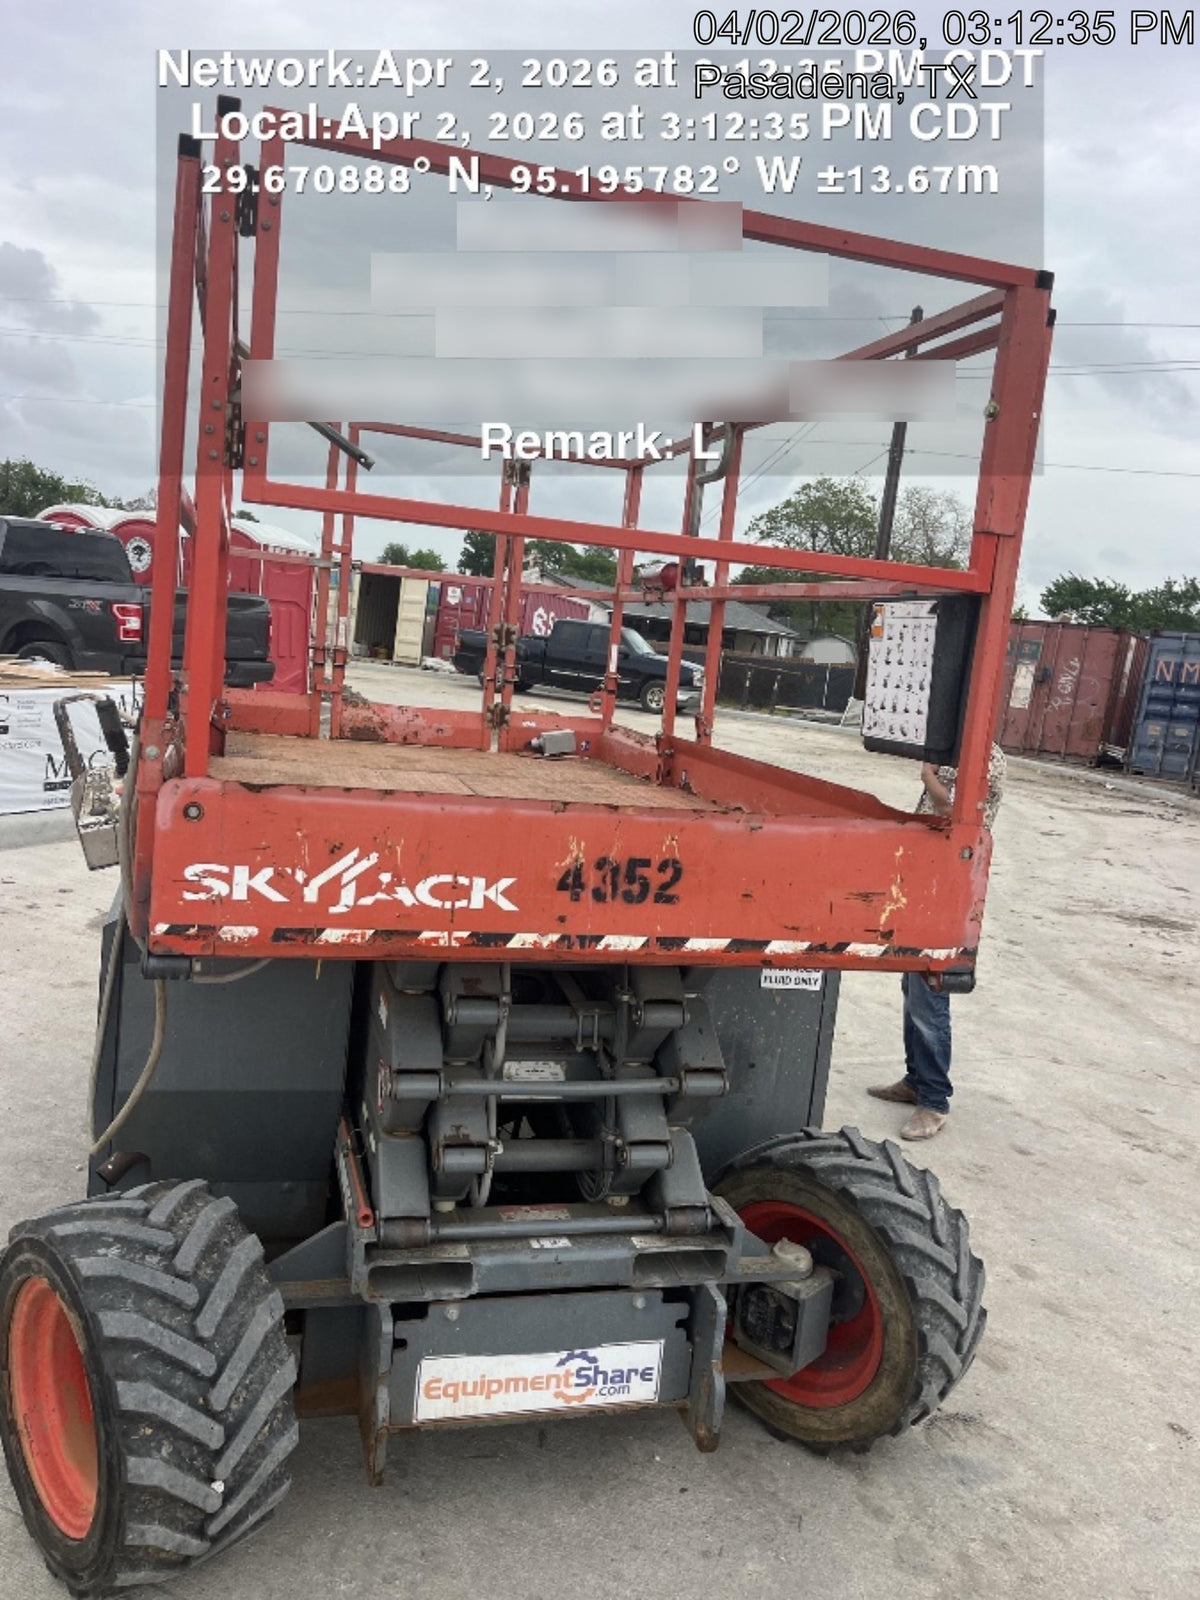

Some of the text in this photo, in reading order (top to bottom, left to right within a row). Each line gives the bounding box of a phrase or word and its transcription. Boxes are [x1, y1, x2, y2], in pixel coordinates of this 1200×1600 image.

[182, 846, 519, 914] SKYJACK
[556, 856, 683, 907] 4352
[794, 976, 819, 987] ONLY
